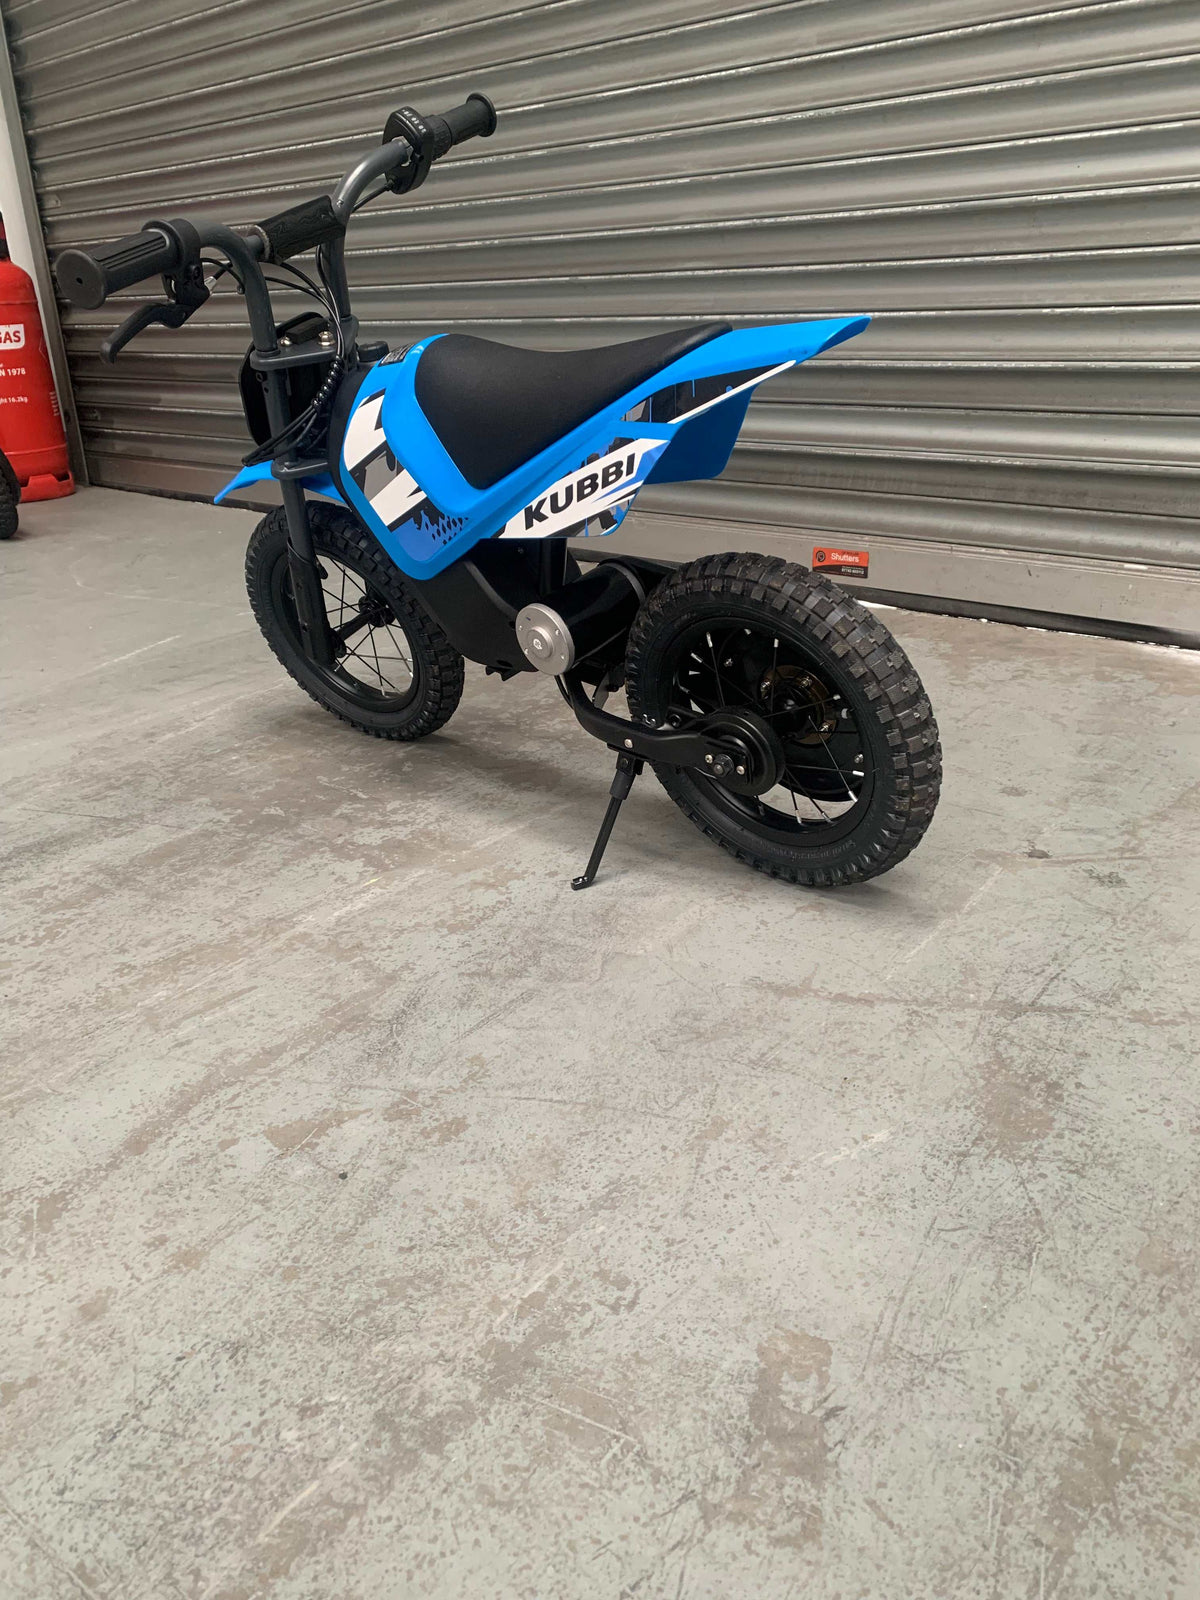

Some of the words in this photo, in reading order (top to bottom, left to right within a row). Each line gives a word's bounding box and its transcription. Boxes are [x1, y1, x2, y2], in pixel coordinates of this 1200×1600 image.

[0, 330, 21, 344] AS
[7, 367, 26, 376] 1978
[524, 453, 636, 530] KUBBI
[831, 552, 860, 563] Shutters
